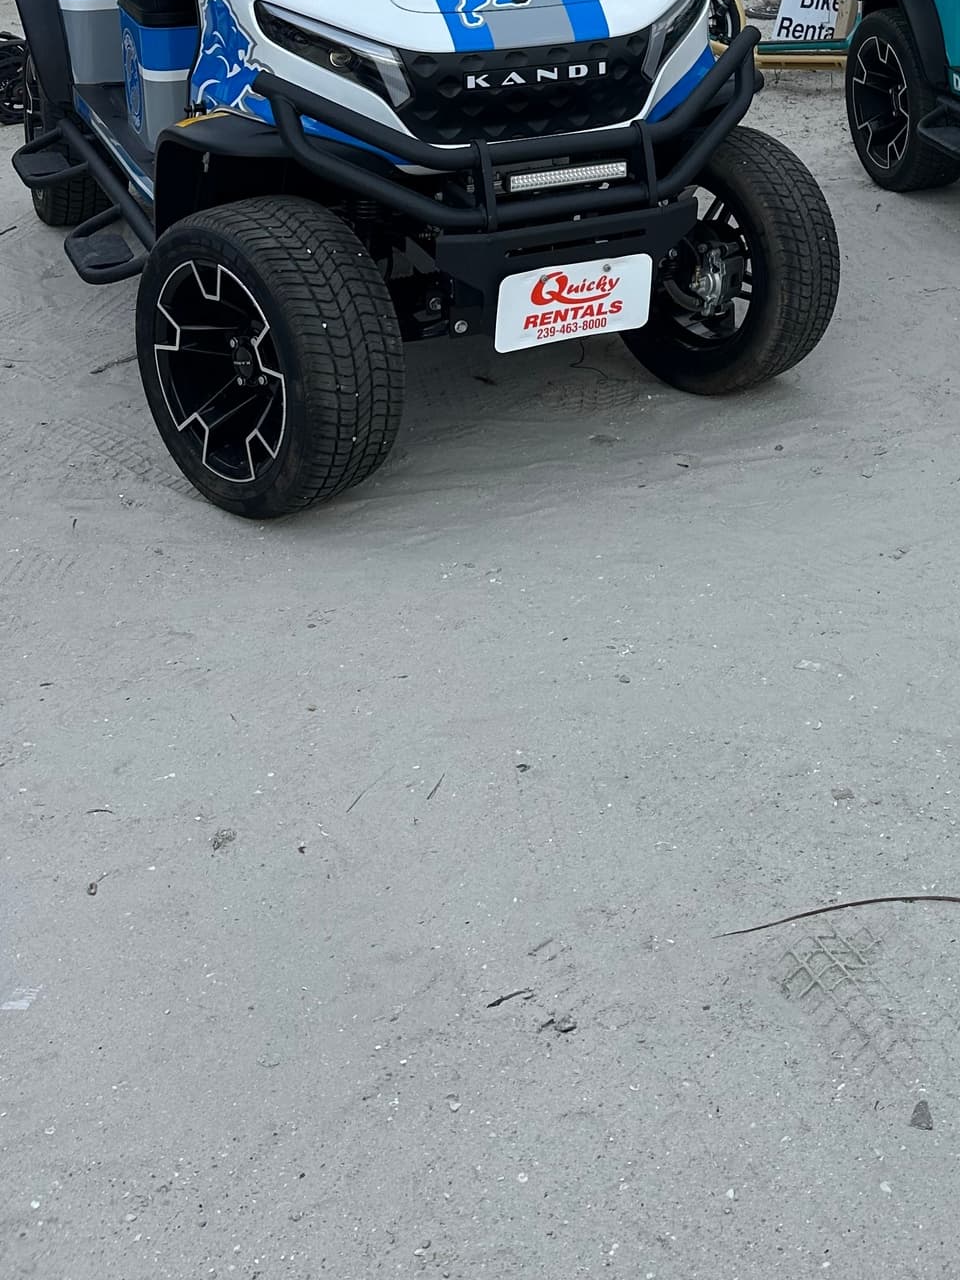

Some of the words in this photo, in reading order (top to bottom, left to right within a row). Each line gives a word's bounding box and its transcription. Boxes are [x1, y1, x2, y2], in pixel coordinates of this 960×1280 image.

[776, 16, 835, 40] Renta
[466, 61, 607, 89] KANDI
[523, 300, 624, 330] RENTALS
[536, 317, 608, 340] 239-463-8000
